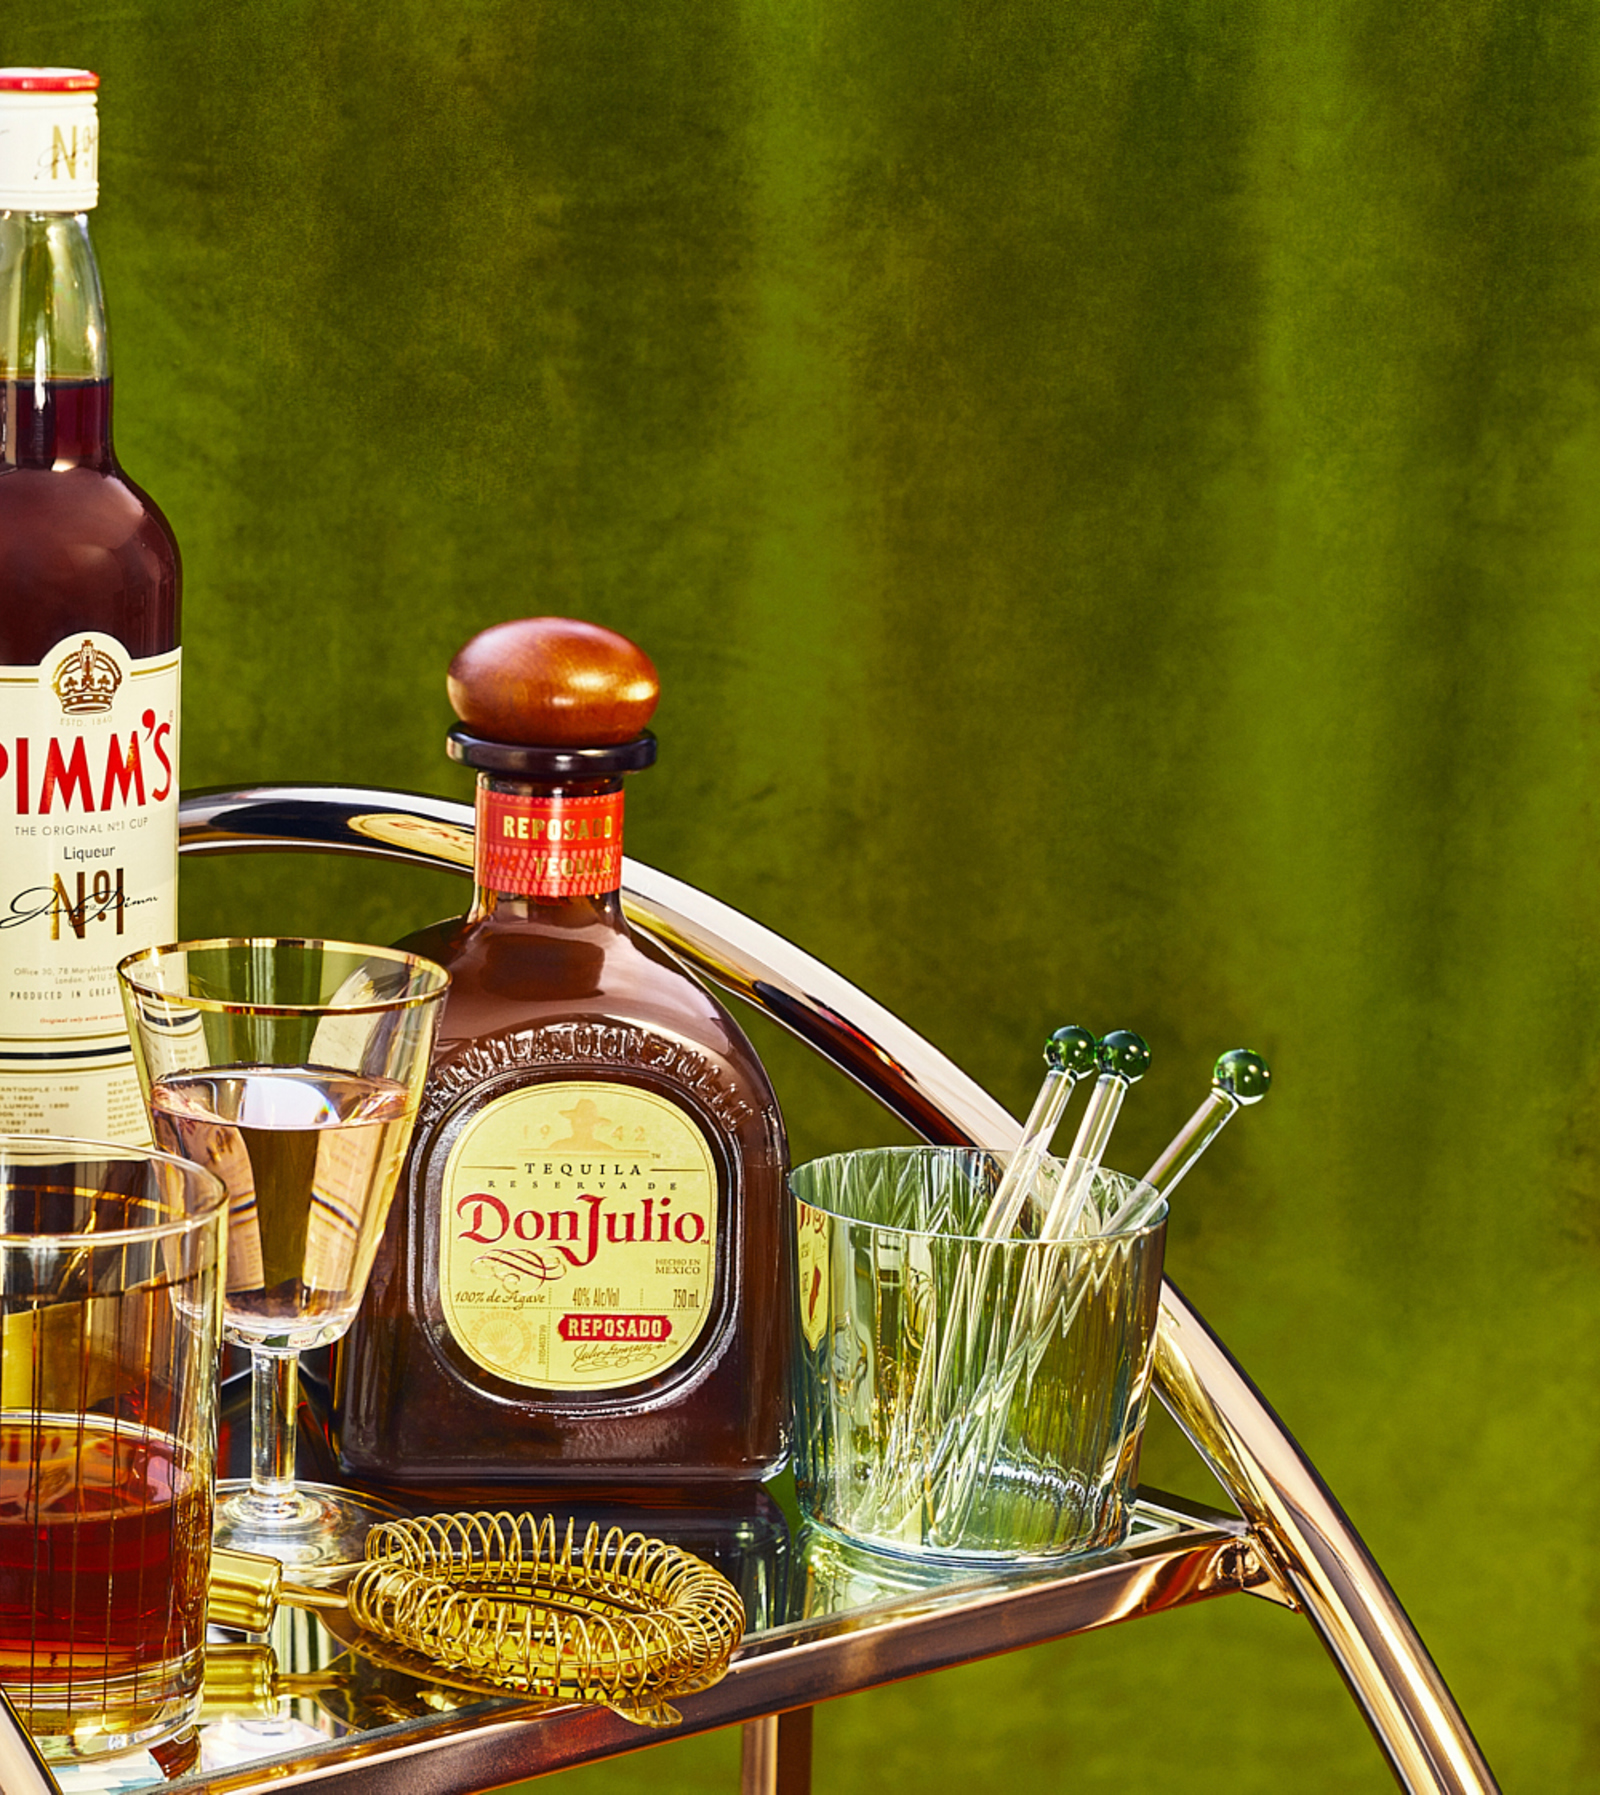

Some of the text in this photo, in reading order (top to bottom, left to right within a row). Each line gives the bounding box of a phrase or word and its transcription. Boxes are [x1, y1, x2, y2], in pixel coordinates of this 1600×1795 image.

[14, 825, 37, 836] THE
[42, 824, 103, 836] ORIGINAL
[129, 817, 149, 831] CUP
[503, 815, 613, 841] REPOSADO
[64, 846, 116, 863] Liqueur
[534, 854, 612, 877] TEQUILA
[14, 967, 39, 976] Office
[10, 986, 117, 1001] PRODUCED IN GREAT
[525, 1162, 642, 1177] TEQUILA
[487, 1180, 677, 1191] RESERVA DE
[655, 1266, 701, 1275] MEXICO
[454, 1289, 546, 1310] 100% de Agave
[571, 1287, 591, 1307] 40%
[568, 1318, 663, 1338] REPOSADO
